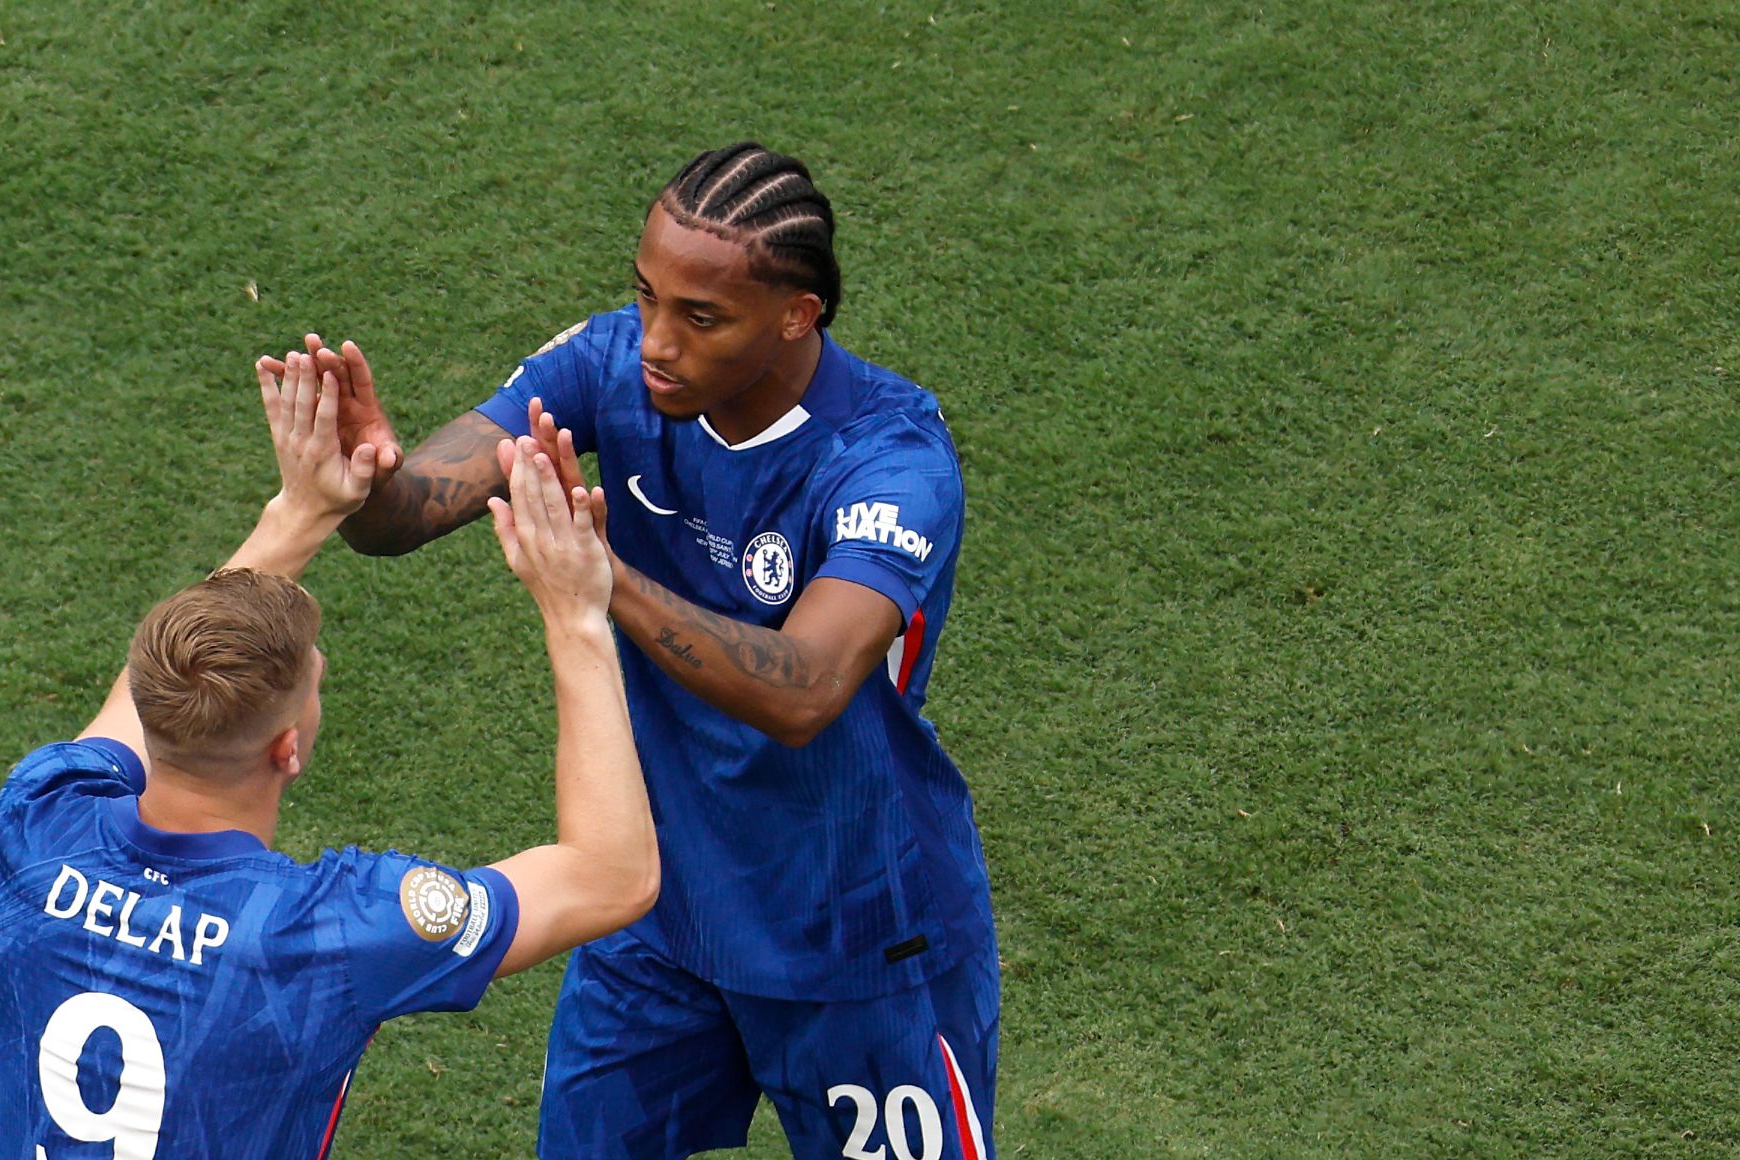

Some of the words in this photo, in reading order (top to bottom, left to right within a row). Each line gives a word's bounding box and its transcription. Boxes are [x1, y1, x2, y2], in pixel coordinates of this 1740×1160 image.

[836, 502, 899, 526] LIVE
[754, 534, 788, 553] CHELSEA
[836, 521, 934, 562] NATION
[143, 867, 170, 886] CFC
[410, 872, 425, 888] CUP
[44, 864, 230, 965] DELAP
[408, 889, 426, 926] WORLD
[450, 896, 465, 926] FIFA
[425, 923, 448, 934] CLUB
[460, 913, 478, 945] FOOTBALL
